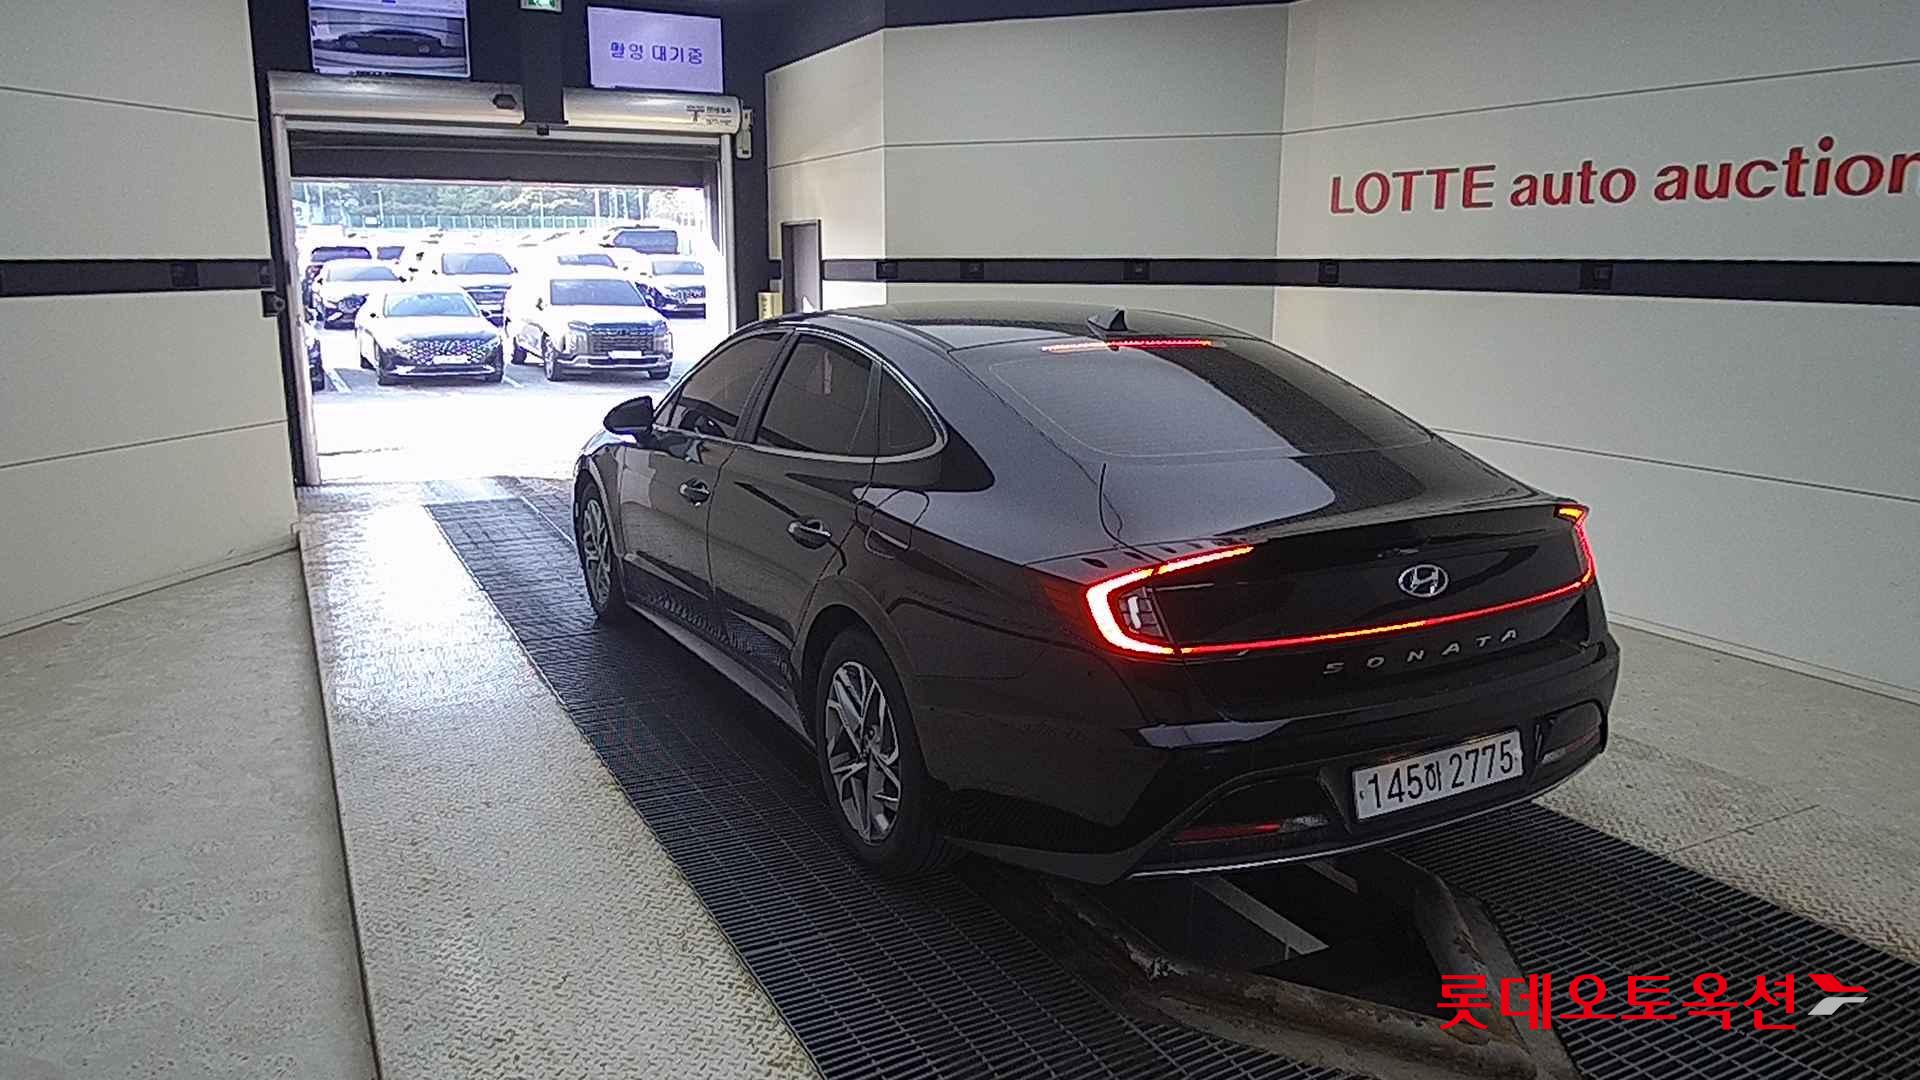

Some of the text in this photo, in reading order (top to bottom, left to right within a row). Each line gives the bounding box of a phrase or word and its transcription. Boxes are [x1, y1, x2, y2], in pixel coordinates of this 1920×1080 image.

[1331, 165, 1496, 214] LOTTE
[1510, 160, 1637, 206] auto
[1323, 629, 1518, 675] SONATA
[1449, 740, 1513, 789] 2775
